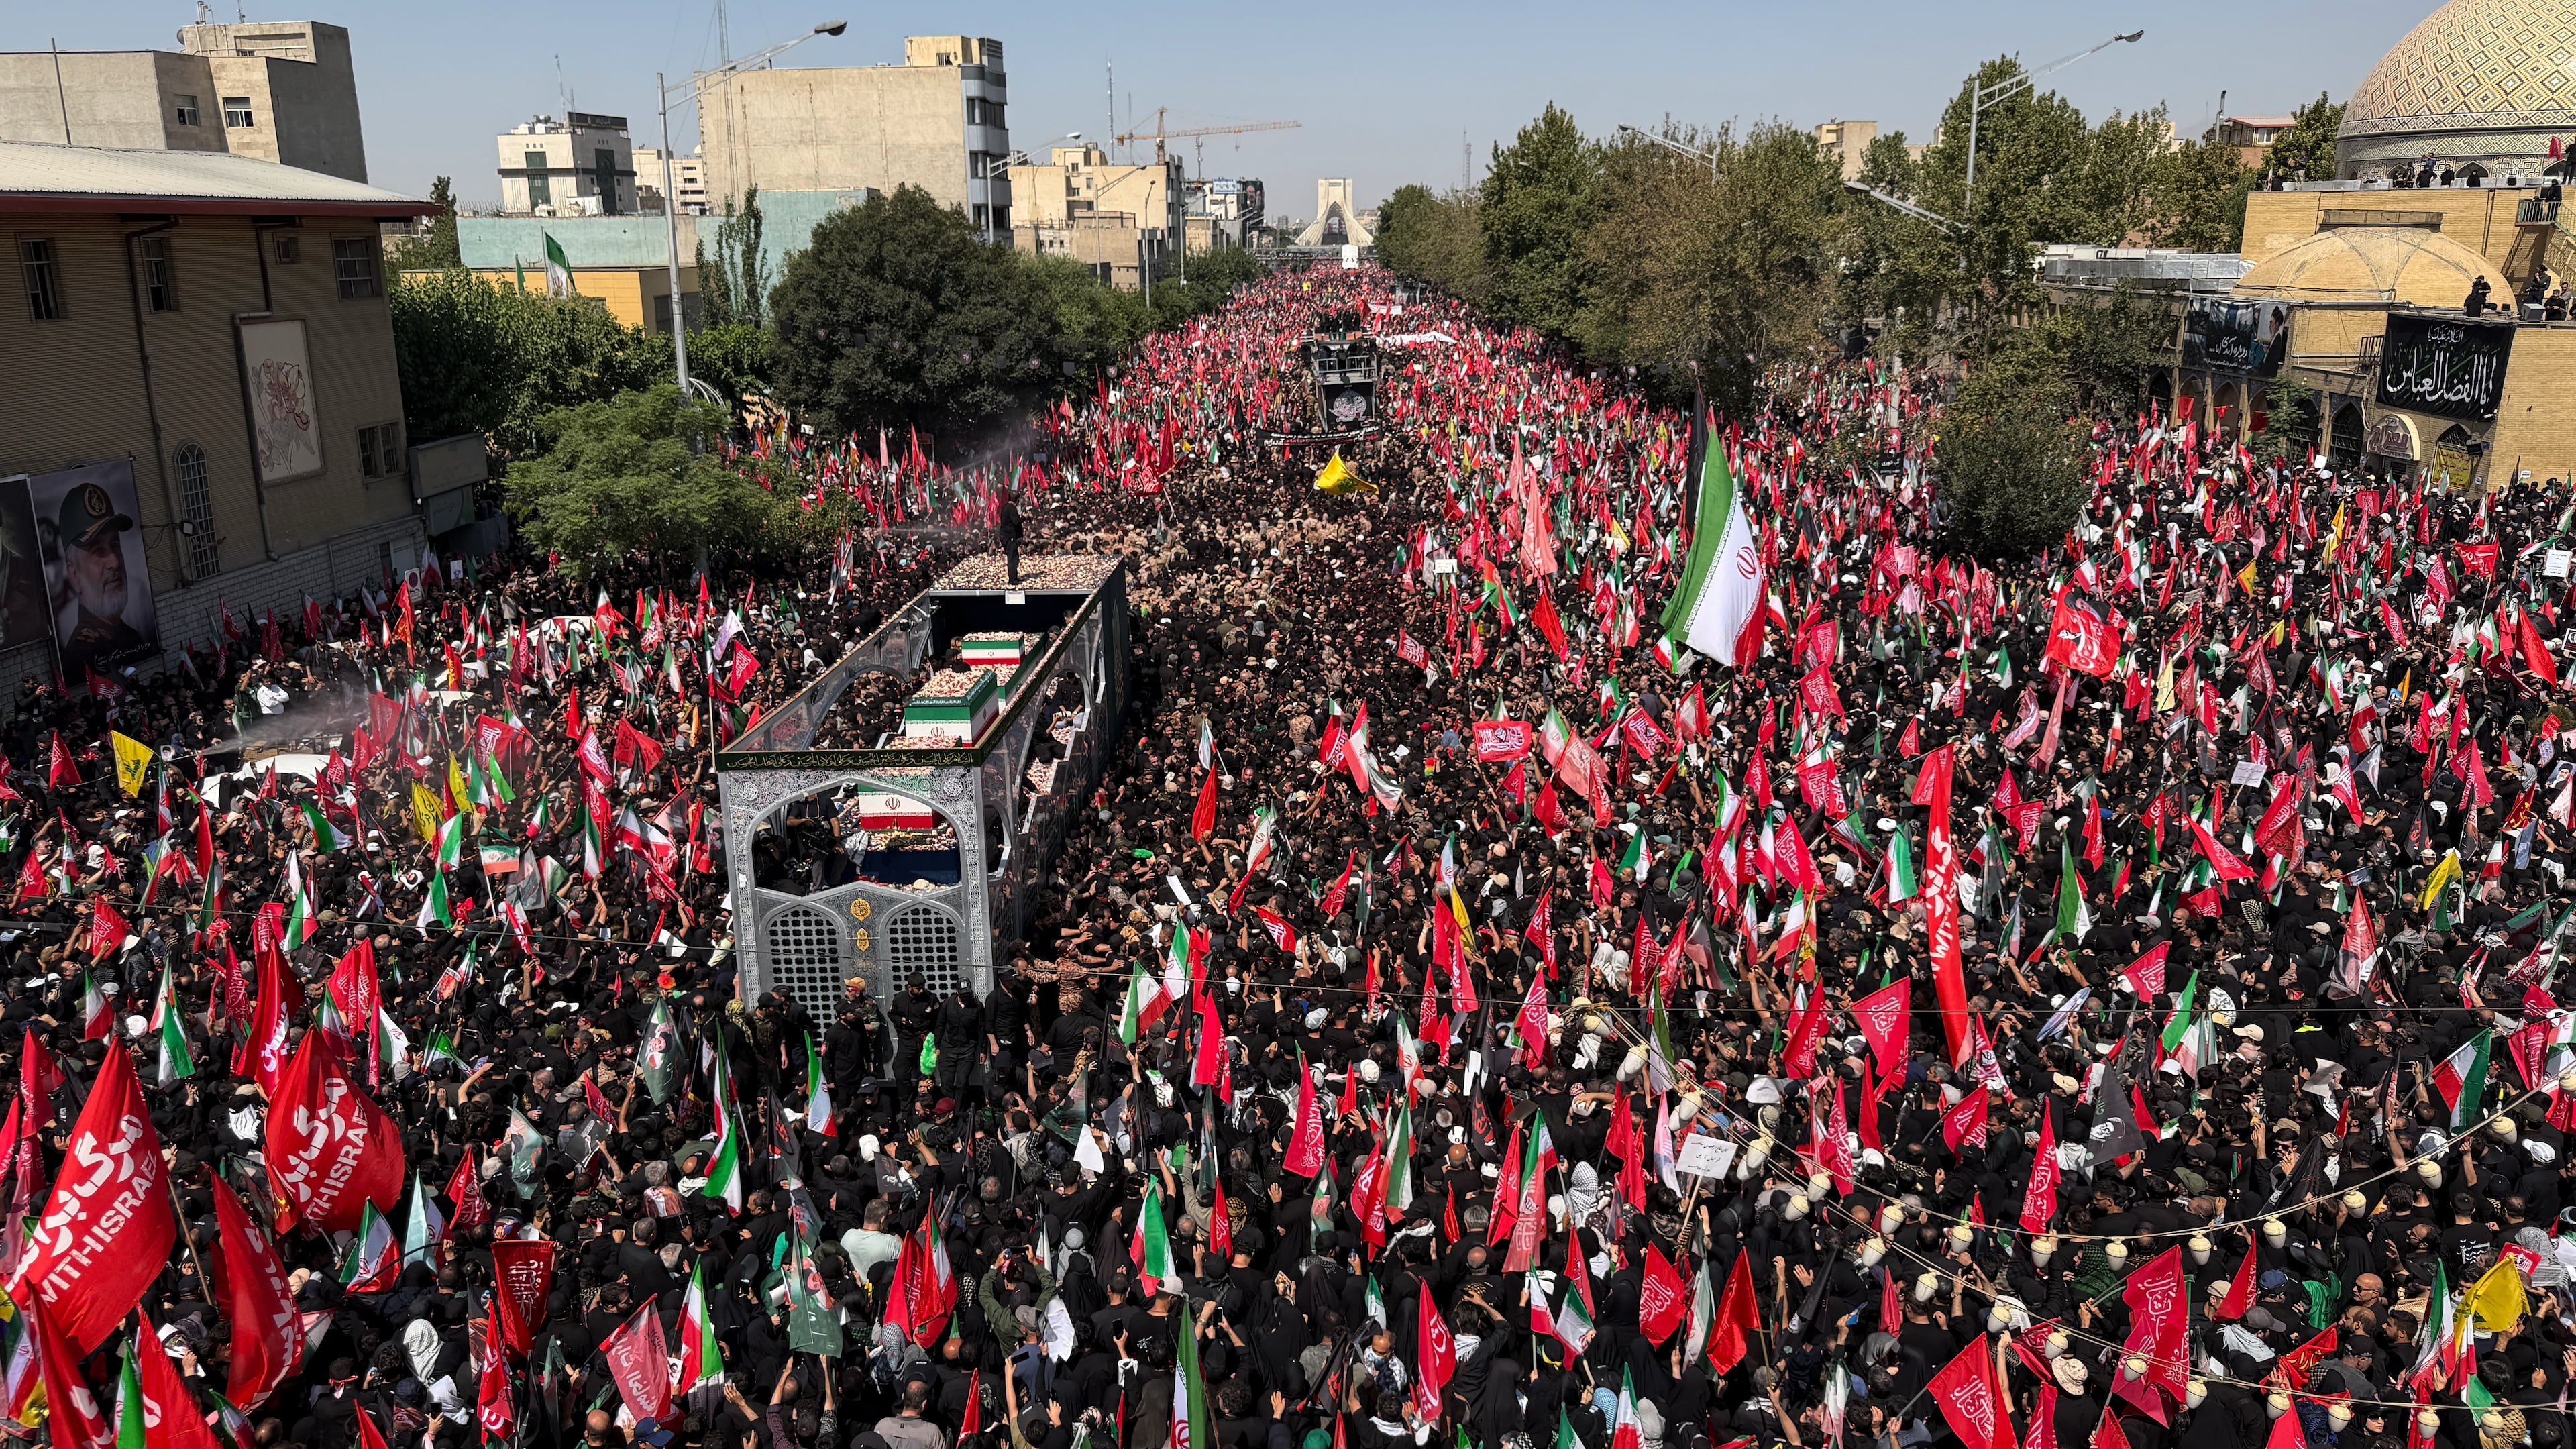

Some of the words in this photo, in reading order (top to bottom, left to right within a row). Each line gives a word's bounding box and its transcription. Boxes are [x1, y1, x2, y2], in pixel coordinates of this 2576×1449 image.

[73, 1114, 144, 1197] مرگ
[294, 1078, 348, 1161] مرگ
[45, 1190, 87, 1258] بر
